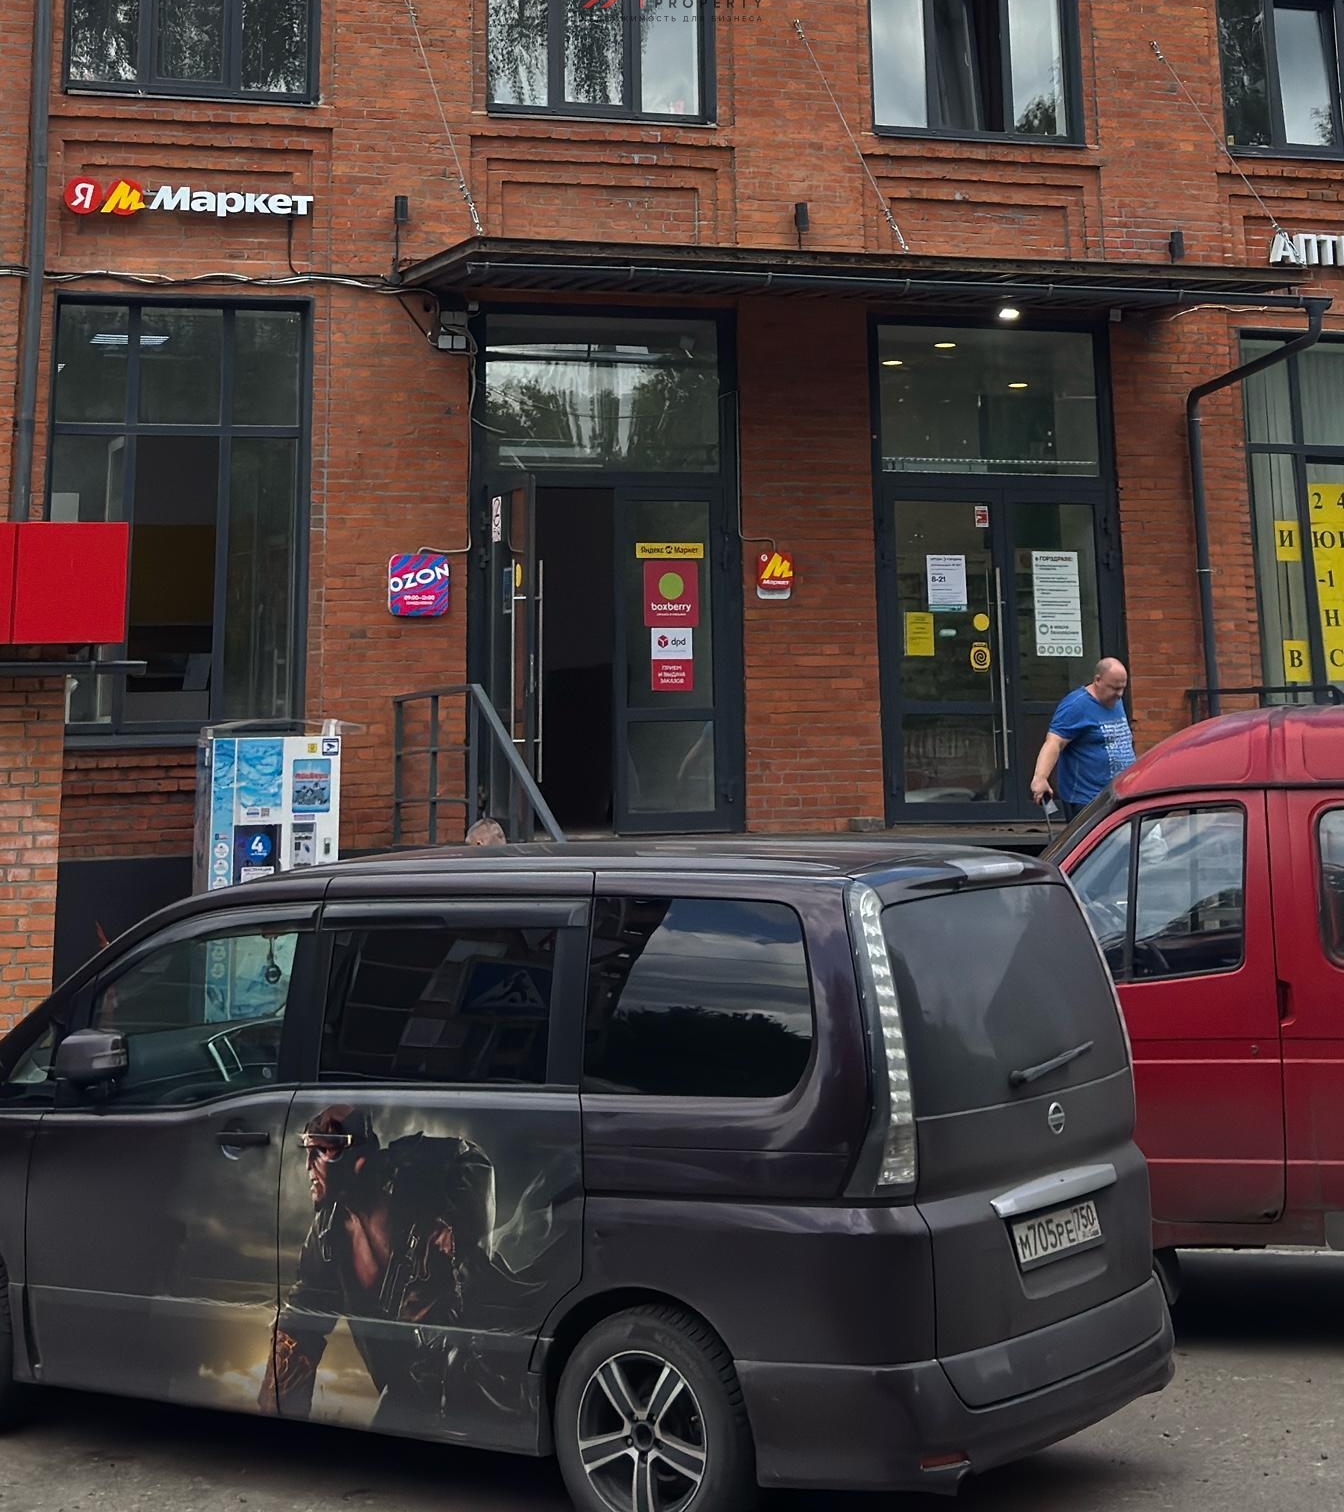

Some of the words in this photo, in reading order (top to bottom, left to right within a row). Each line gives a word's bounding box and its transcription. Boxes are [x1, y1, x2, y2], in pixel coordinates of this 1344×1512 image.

[149, 185, 314, 217] Маркет
[390, 563, 450, 593] OZON
[651, 602, 692, 613] boxberry
[670, 637, 687, 647] dpd
[1072, 1204, 1096, 1232] 750
